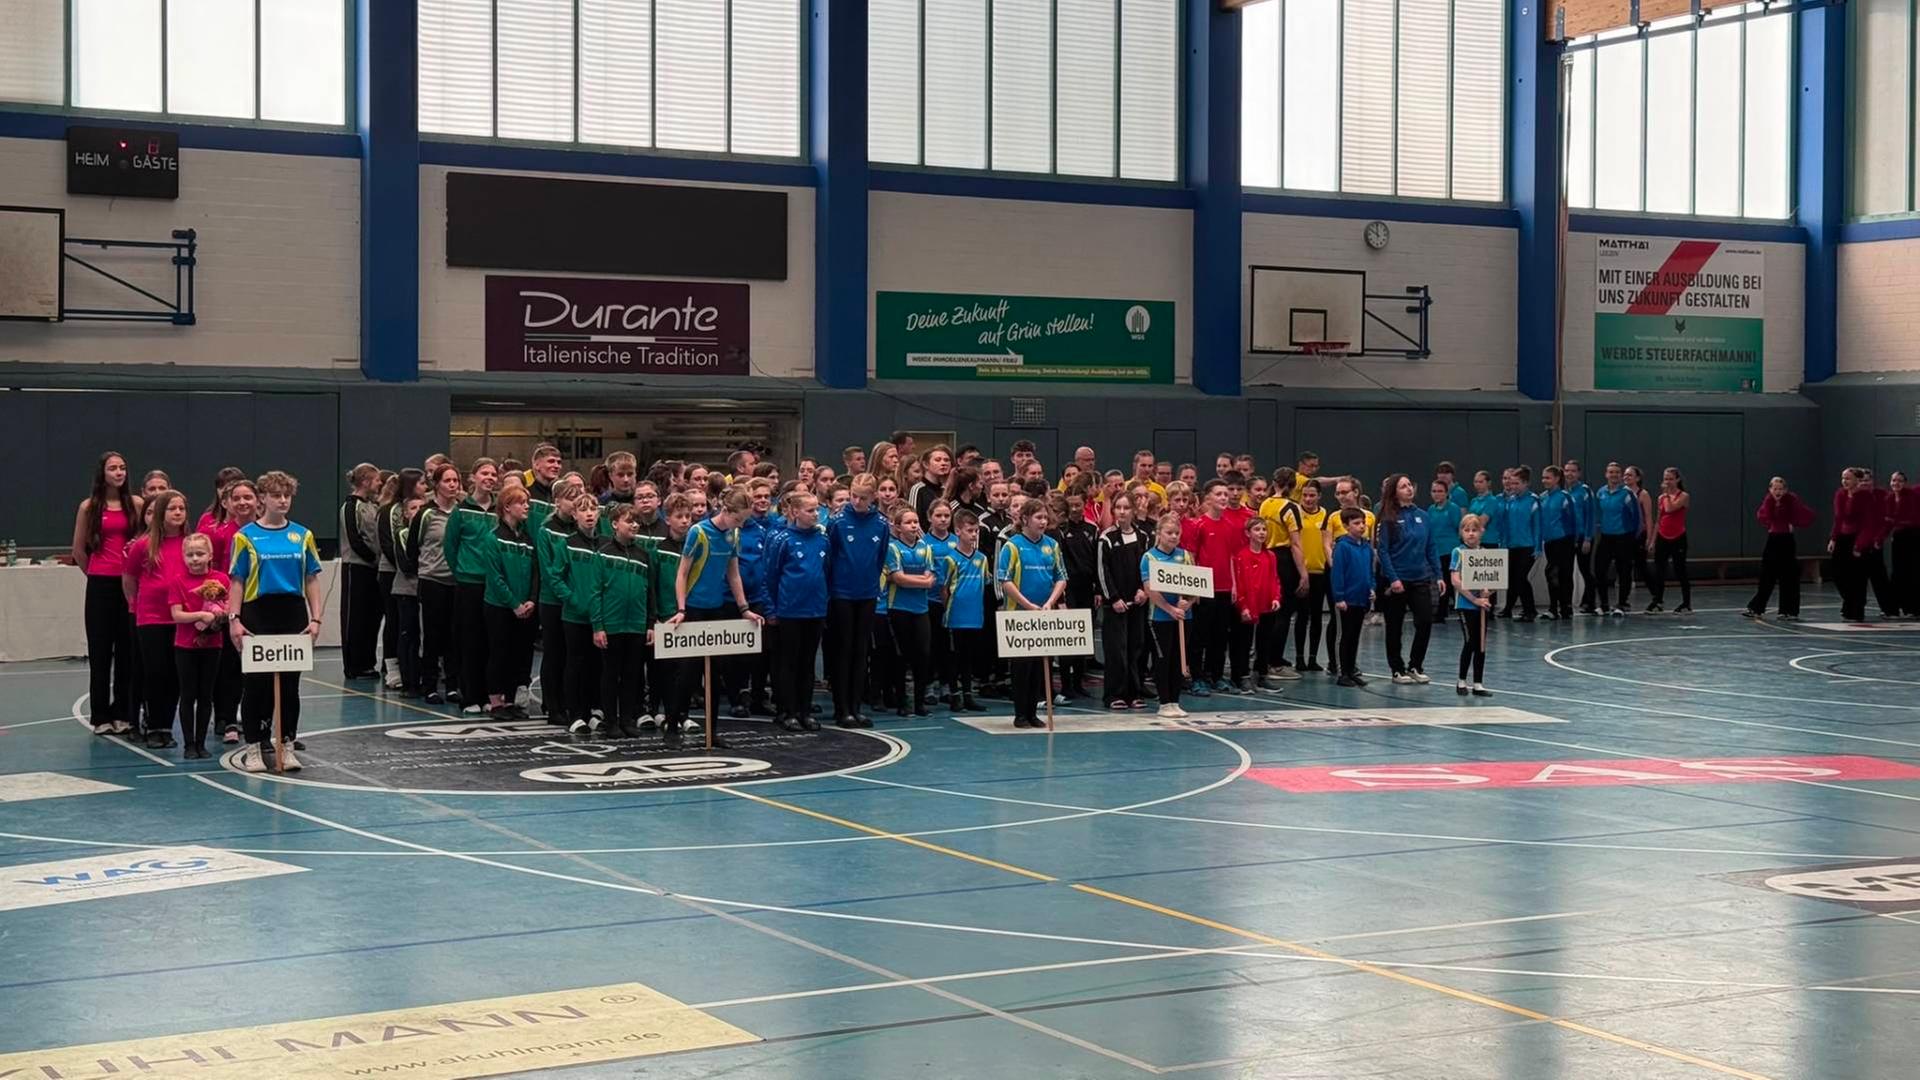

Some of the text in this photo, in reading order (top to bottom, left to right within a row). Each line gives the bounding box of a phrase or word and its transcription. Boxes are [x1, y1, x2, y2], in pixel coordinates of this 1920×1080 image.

[75, 152, 109, 166] HEIM
[1599, 269, 1762, 290] MIT EINER AUSBILDUNG BEI
[1599, 289, 1750, 308] UNS ZUKUNFT GESTALTEN
[520, 291, 719, 331] Durante
[906, 299, 1010, 331] Deine Zukunft
[978, 313, 1094, 347] auf Grün stellen!
[524, 344, 719, 366] Italienische Tradition
[1601, 347, 1757, 363] WERDE STEUERFACHMANN!
[1468, 556, 1504, 567] Sachsen
[1157, 569, 1208, 589] Sachsen
[1472, 571, 1500, 582] Anhalt
[1005, 618, 1086, 634] Mecklenburg
[664, 631, 755, 648] Brandenburg
[1006, 636, 1087, 651] Vorpommern
[252, 645, 304, 662] Berlin
[1328, 761, 1843, 787] SAS
[13, 856, 214, 885] WAG
[344, 1029, 662, 1077] www.akuhlmann.de
